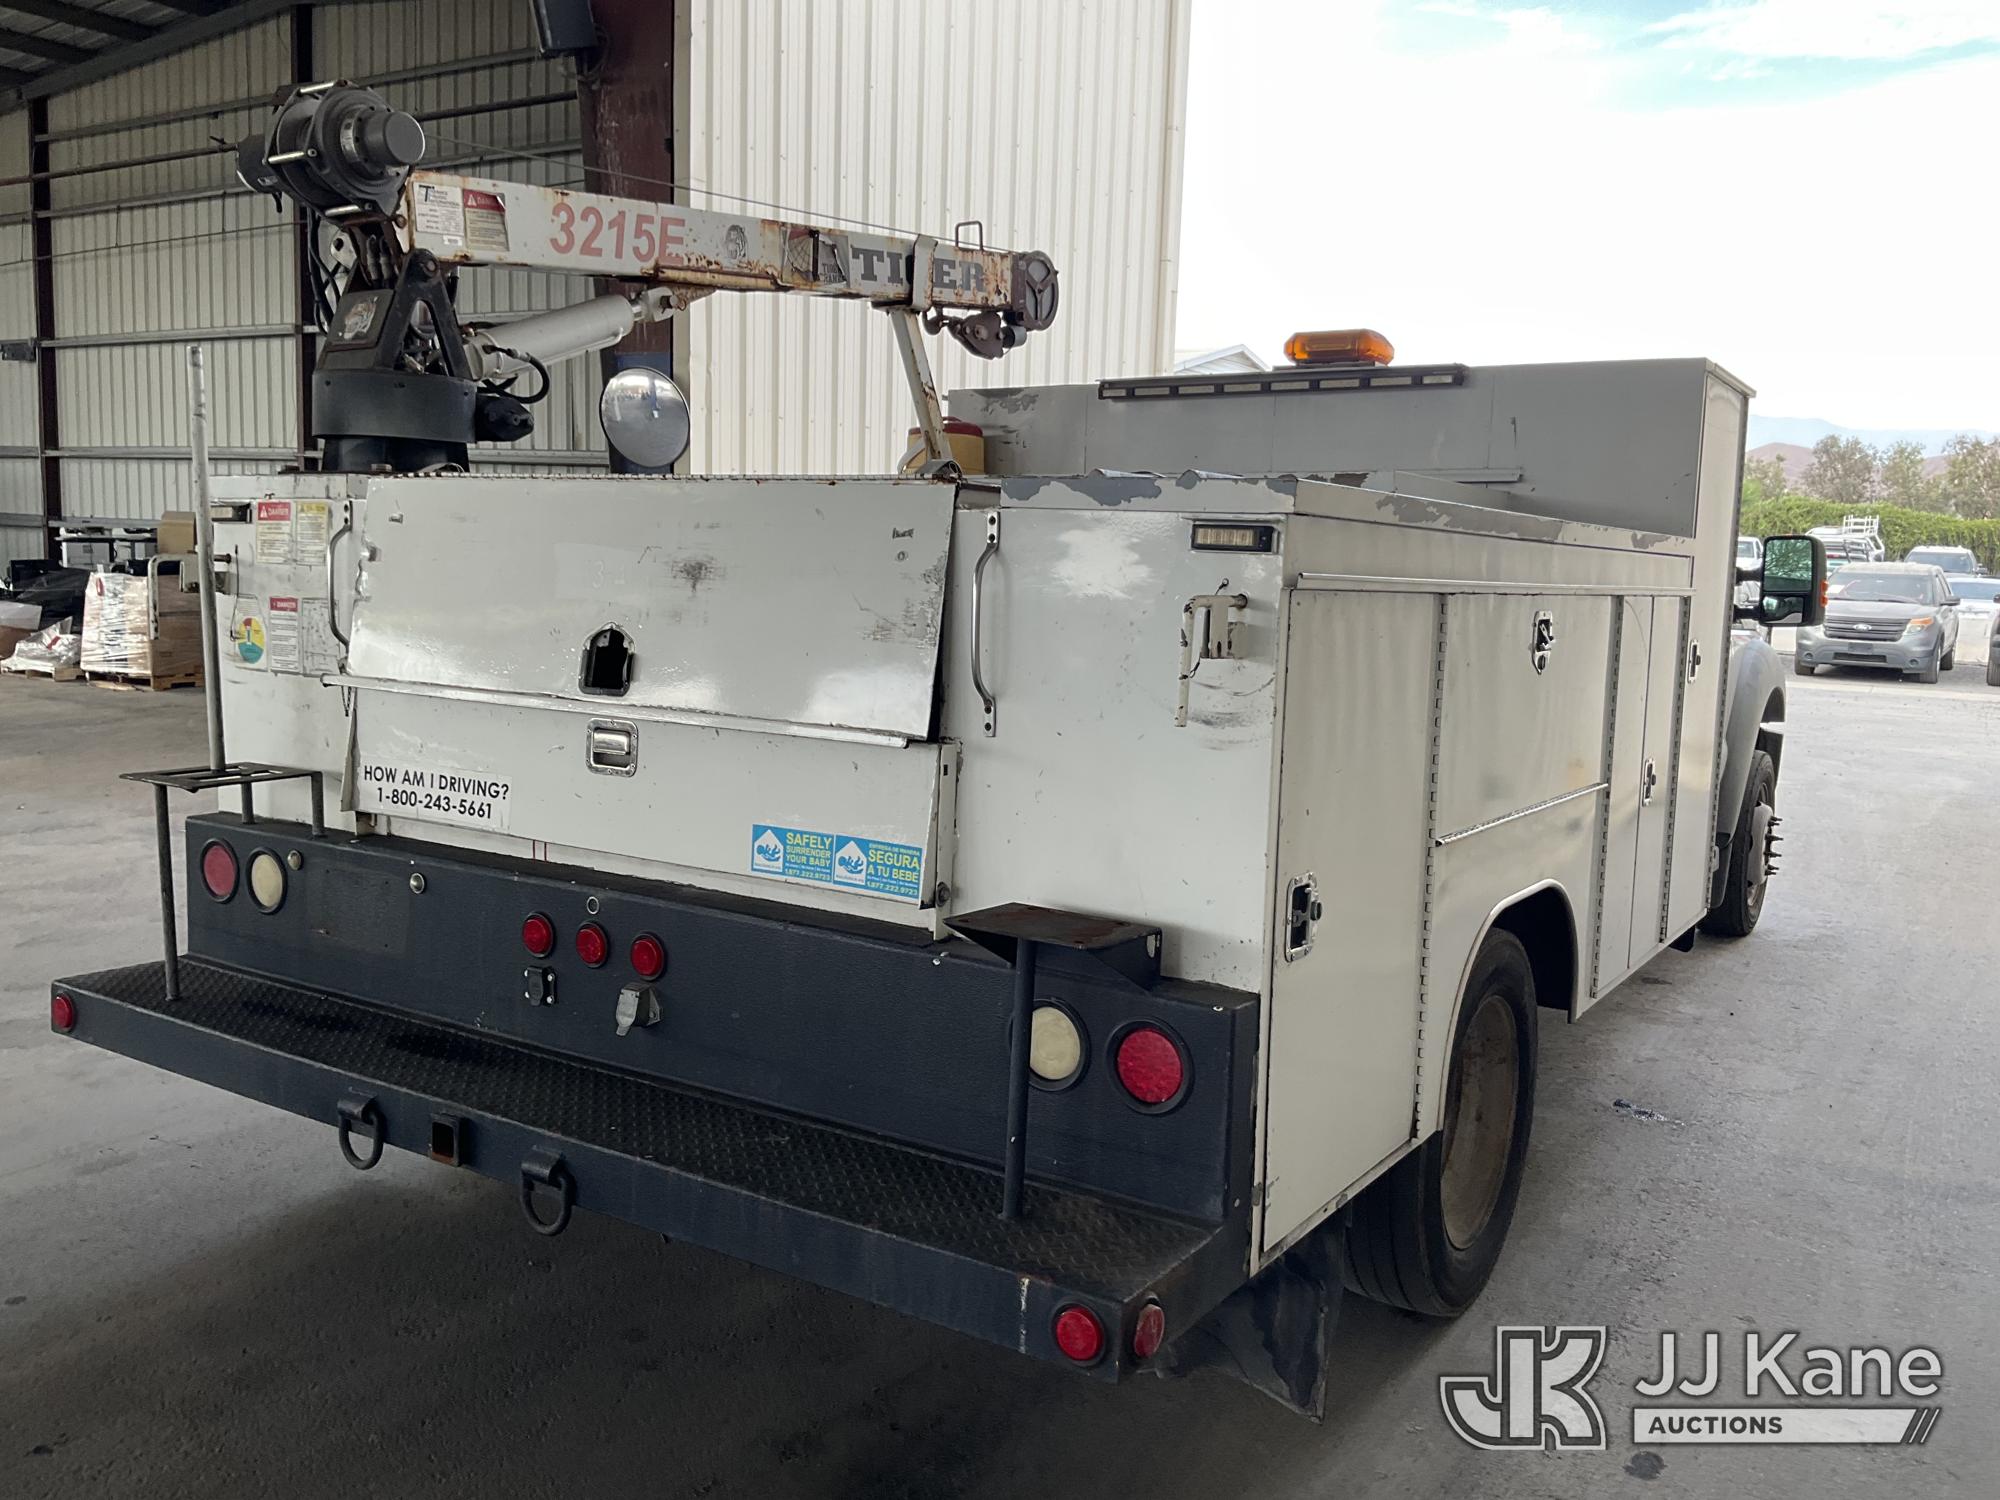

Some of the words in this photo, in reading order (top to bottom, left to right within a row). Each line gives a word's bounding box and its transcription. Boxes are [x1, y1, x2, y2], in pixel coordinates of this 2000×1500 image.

[549, 201, 686, 266] 3215E
[851, 246, 985, 292] TIER
[364, 765, 397, 783] HOW
[402, 769, 425, 788] AM
[430, 773, 434, 788] I
[439, 775, 509, 800] DRIVING?
[377, 787, 492, 819] 1-800-243-5661
[786, 832, 832, 850] SAFELY
[786, 845, 831, 858] SURRENDER
[786, 854, 807, 864] YOUR
[809, 857, 831, 867] BABY
[868, 849, 920, 869] SEGURA
[867, 864, 875, 875] A
[877, 865, 890, 878] TU
